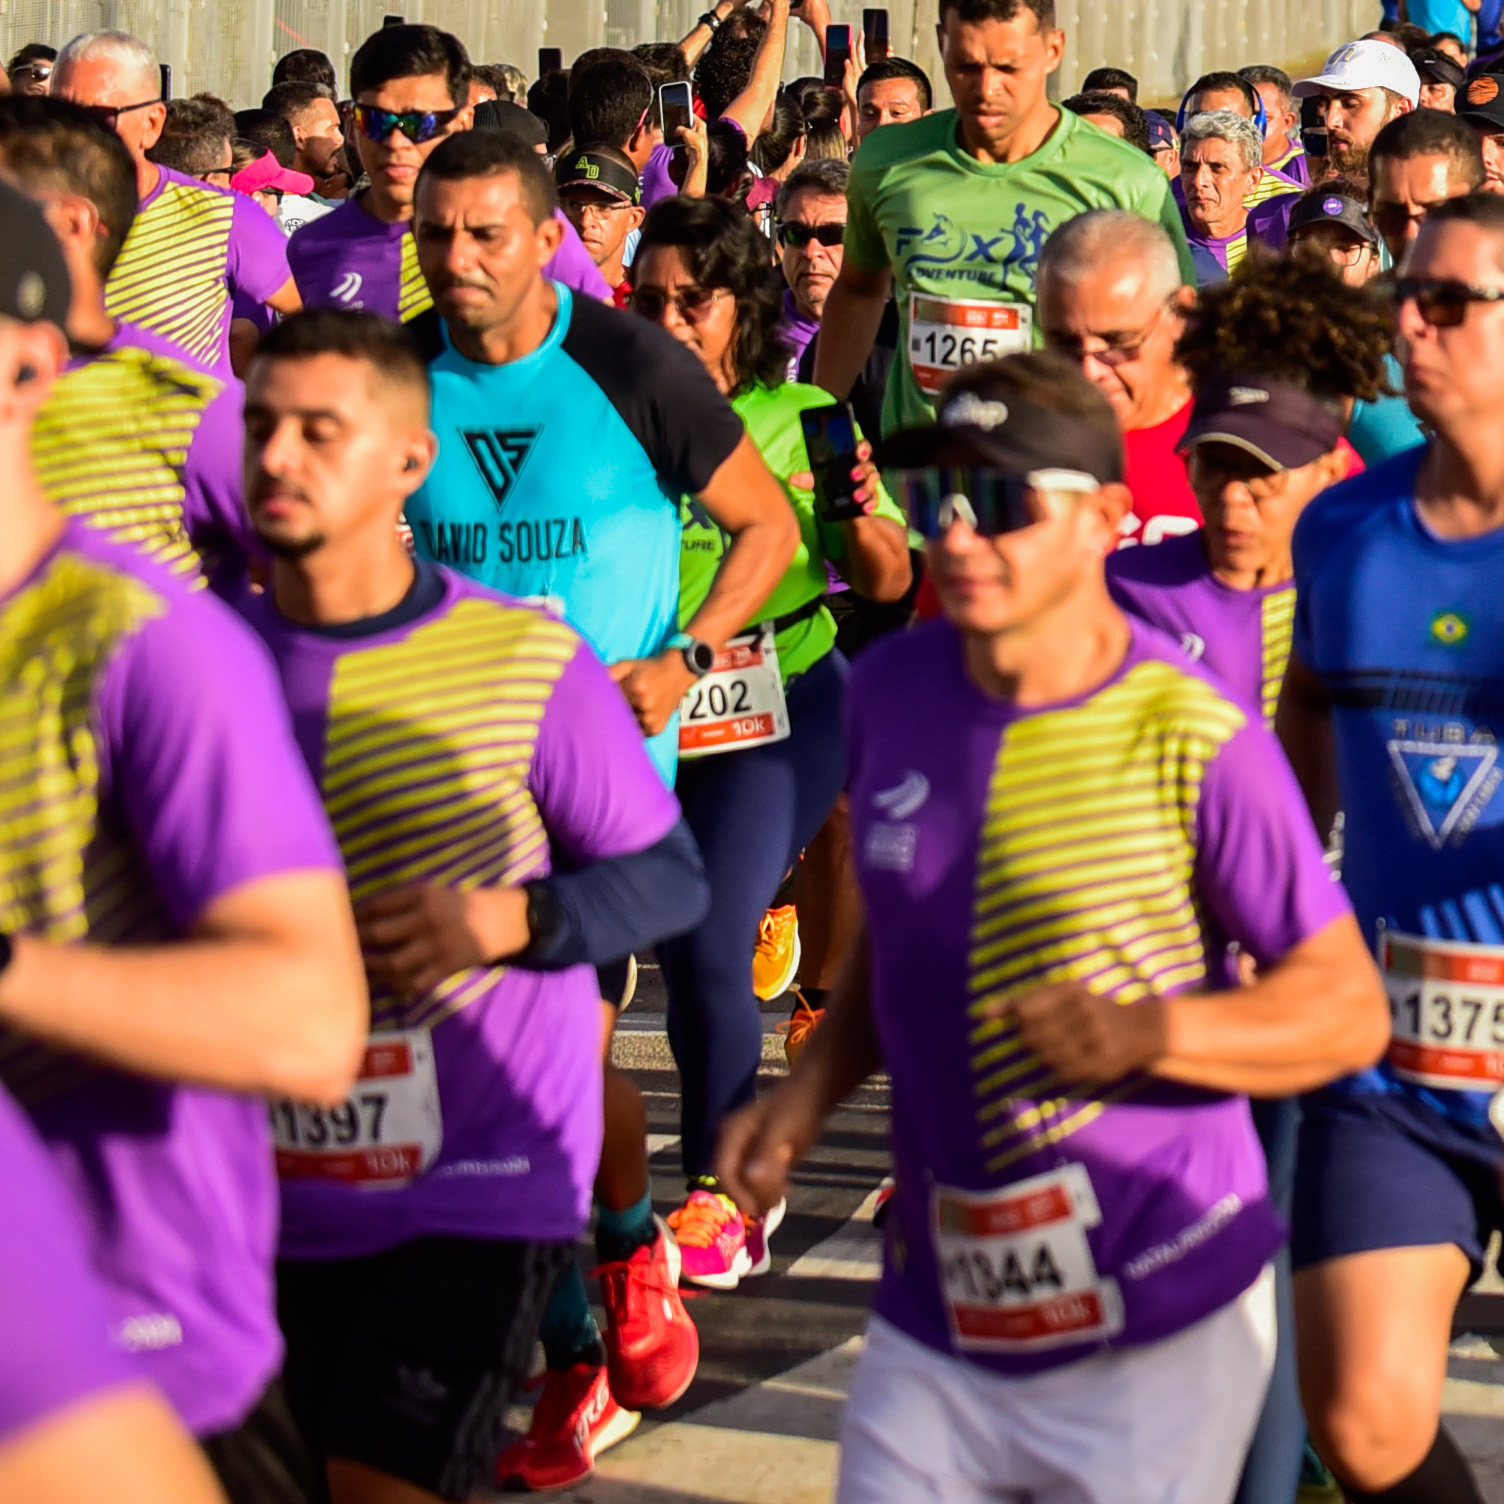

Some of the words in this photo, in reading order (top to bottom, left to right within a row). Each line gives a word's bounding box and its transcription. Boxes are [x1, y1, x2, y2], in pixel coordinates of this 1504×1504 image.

[926, 331, 998, 367] 1265
[500, 517, 588, 563] SOUZA
[681, 680, 751, 720] 202
[733, 717, 765, 735] 10k
[280, 1093, 388, 1148] 1397
